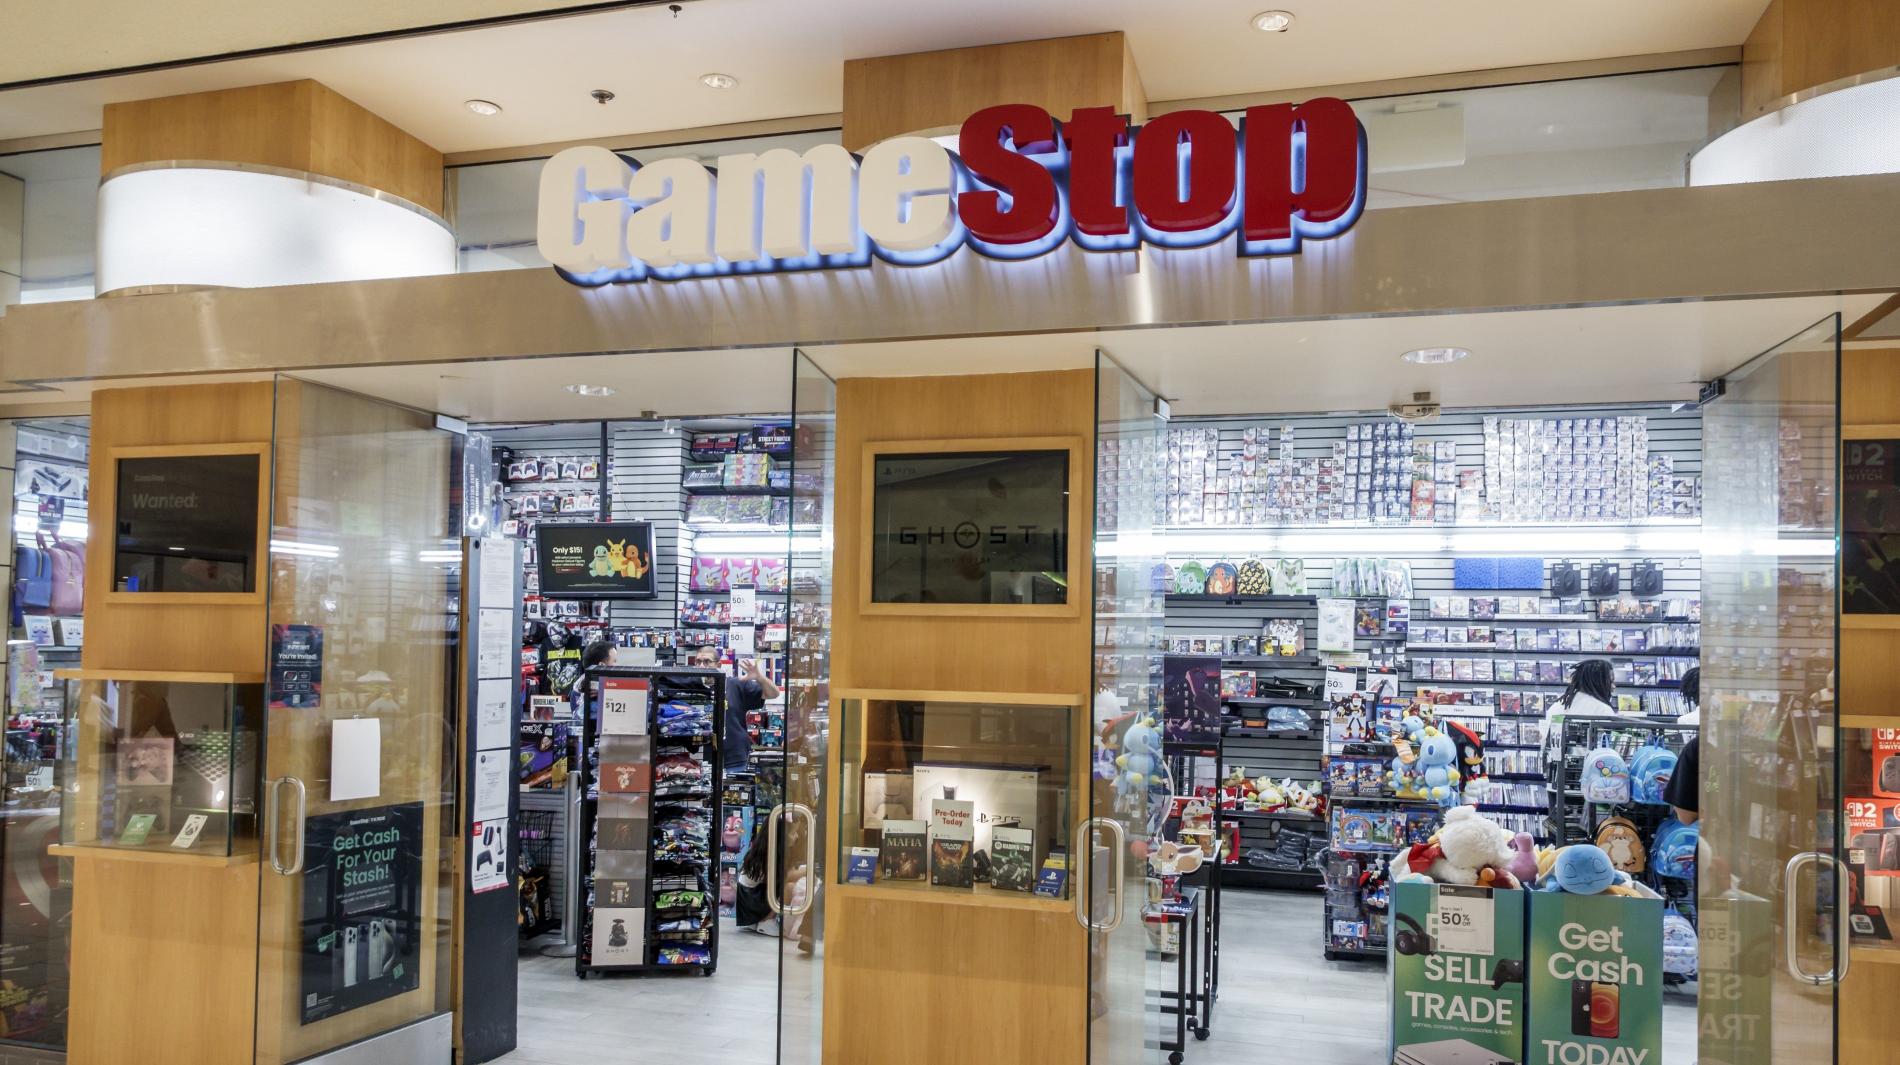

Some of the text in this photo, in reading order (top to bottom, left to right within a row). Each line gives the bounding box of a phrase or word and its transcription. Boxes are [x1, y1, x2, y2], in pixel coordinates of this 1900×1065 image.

[537, 97, 1363, 286] GameStop
[900, 520, 1038, 549] GHOST
[552, 546, 568, 555] Only
[605, 702, 626, 713] $12!
[935, 808, 970, 819] Pre-Order
[991, 815, 1022, 824] PS5
[1863, 802, 1877, 818] 2
[942, 817, 963, 828] Today
[333, 826, 400, 852] Get Cash
[887, 838, 922, 847] MAFIA
[336, 847, 397, 870] For Your
[343, 864, 389, 888] Stash!
[1558, 922, 1623, 953] Get
[1424, 954, 1495, 986] SELL
[1547, 952, 1643, 986] Cash
[1405, 991, 1513, 1026] TRADE
[1541, 1039, 1648, 1065] TODAY
